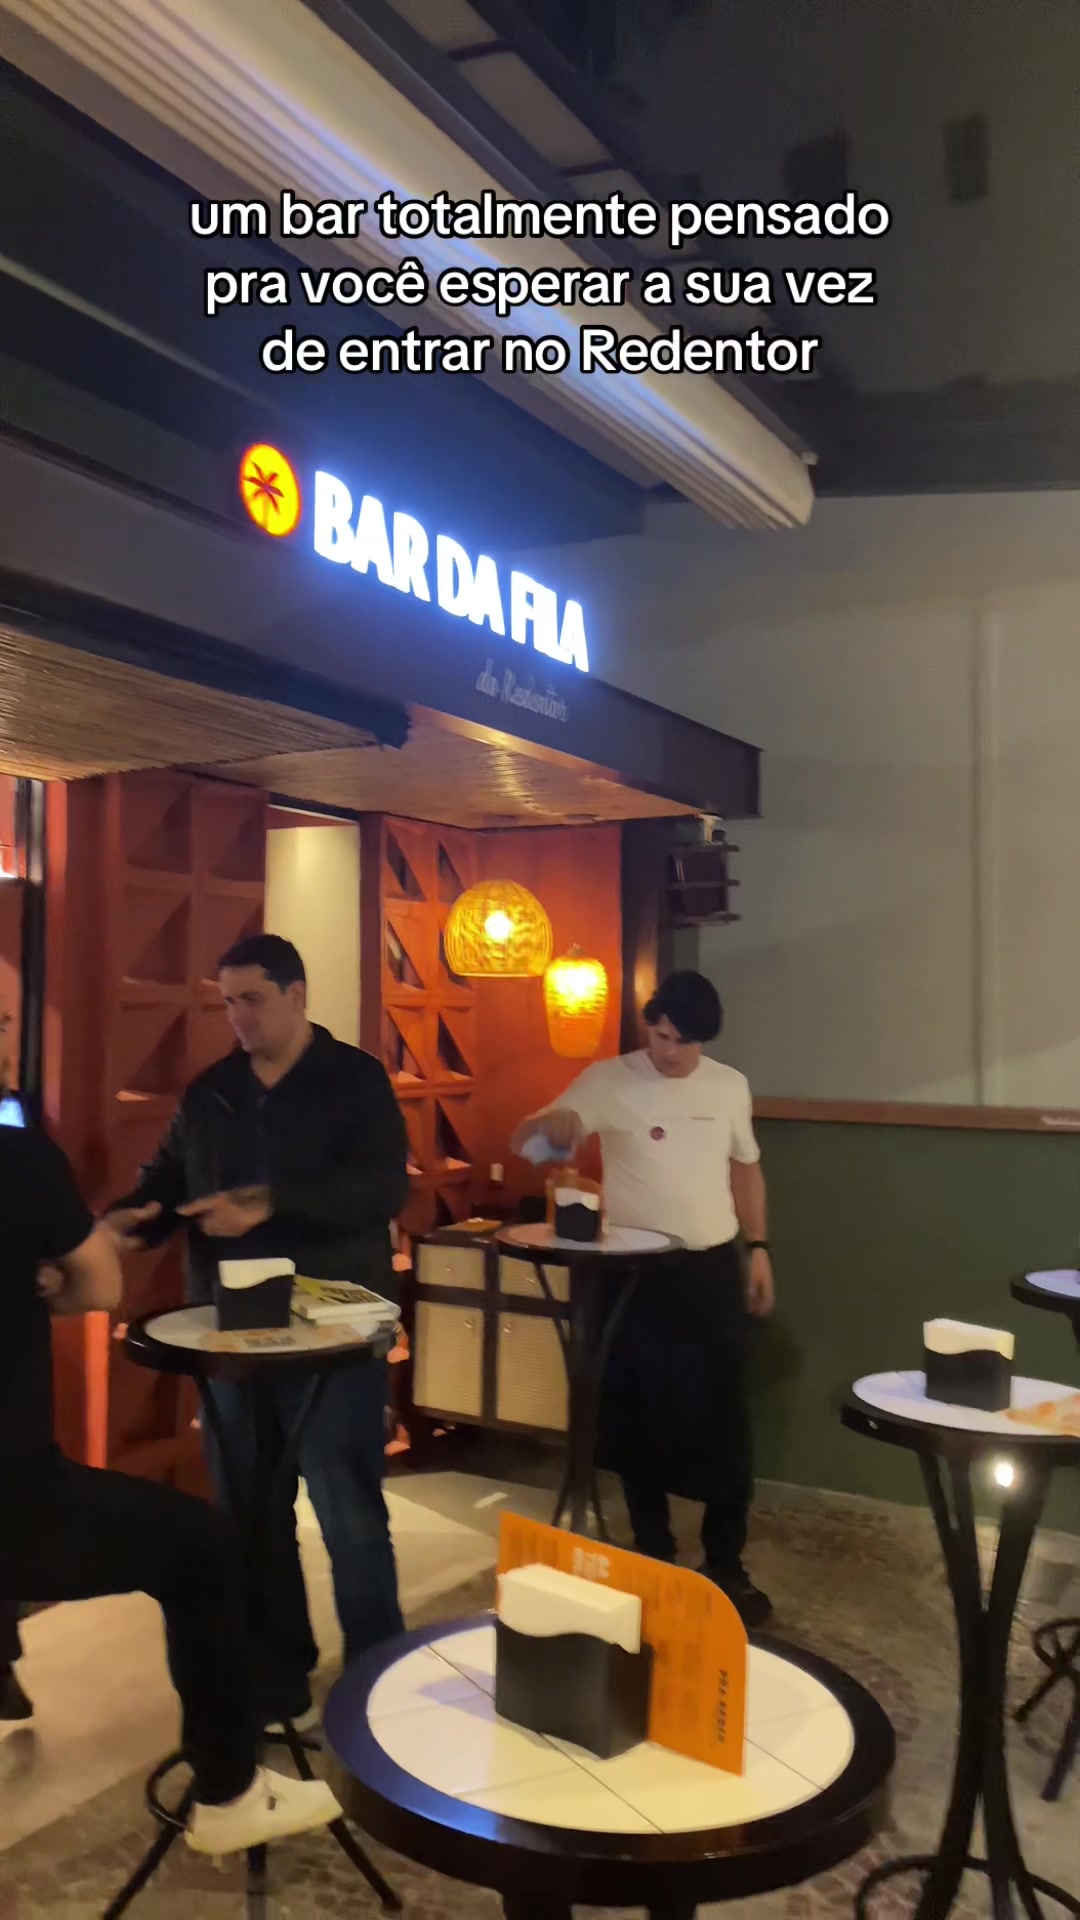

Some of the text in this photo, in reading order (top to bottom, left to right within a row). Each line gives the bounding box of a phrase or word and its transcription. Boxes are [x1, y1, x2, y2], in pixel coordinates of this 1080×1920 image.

[313, 470, 590, 673] BAR DA FILA
